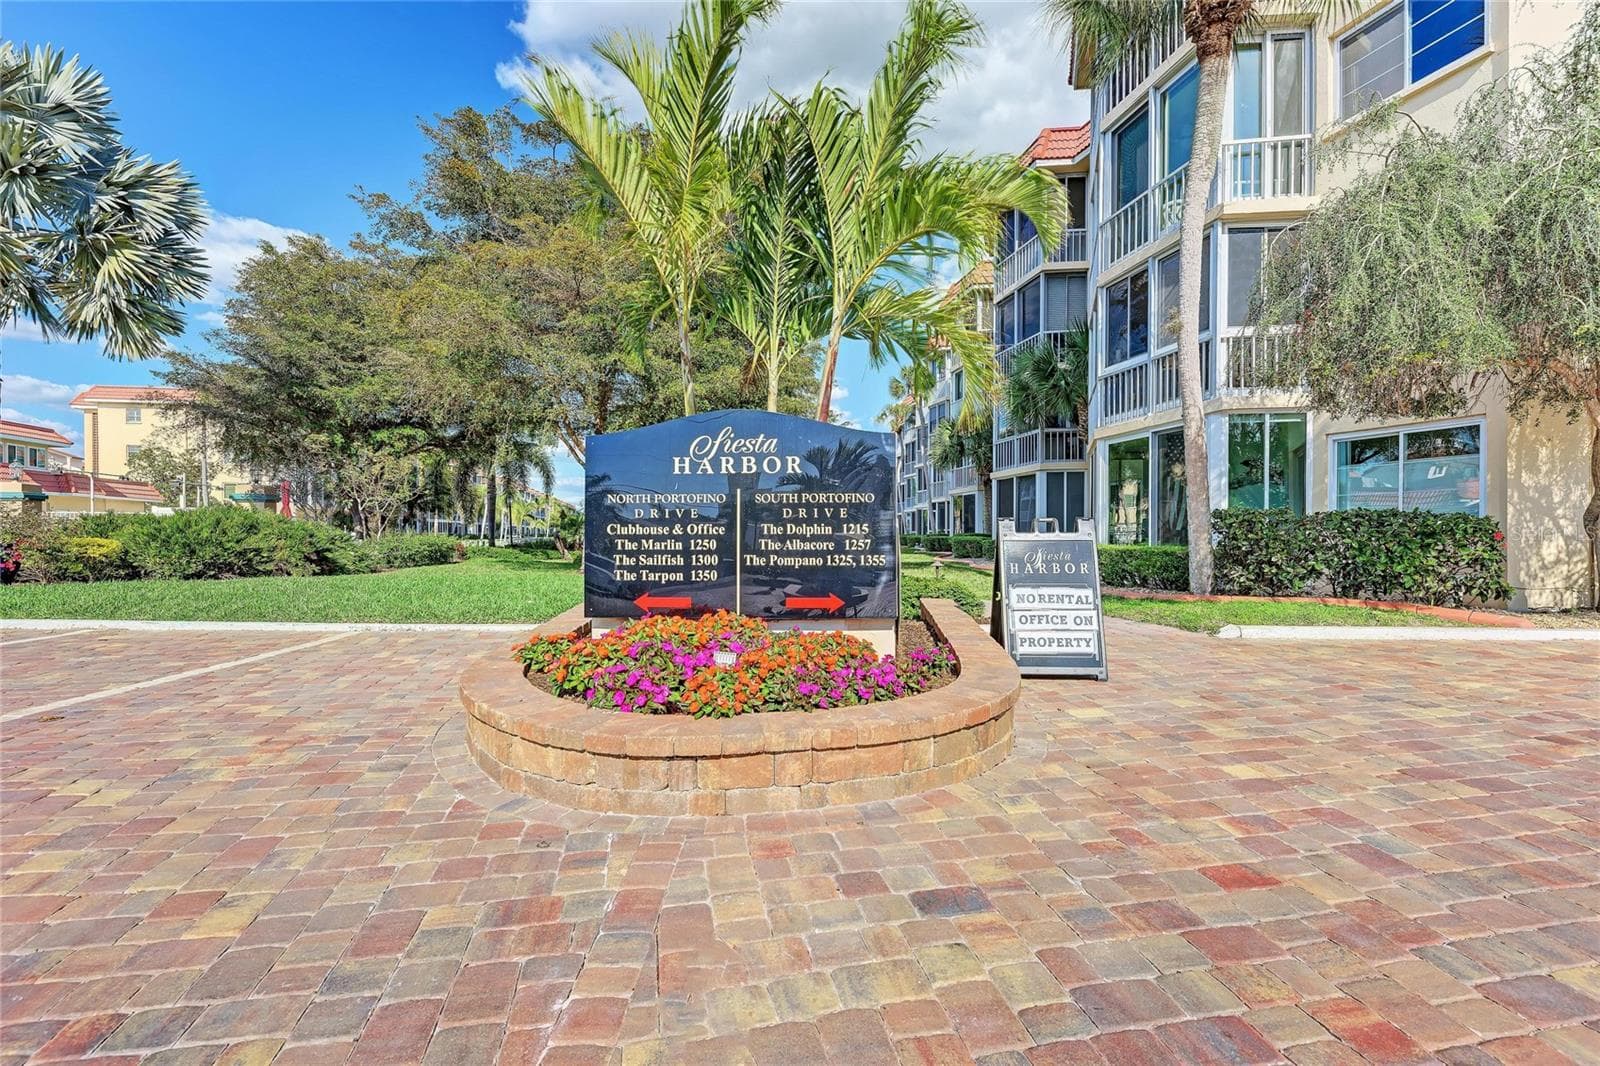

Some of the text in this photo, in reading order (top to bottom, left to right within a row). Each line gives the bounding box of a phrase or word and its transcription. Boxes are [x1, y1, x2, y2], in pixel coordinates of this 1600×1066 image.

[689, 426, 777, 462] Siesta
[672, 456, 803, 474] HARBOR
[607, 493, 726, 504] NORTH PORTOFINO
[754, 492, 875, 504] SOUTH PORTOFINO
[634, 508, 699, 519] DRIVE
[782, 507, 848, 519] DRIVE
[606, 523, 726, 536] Clubhouse & Office
[760, 523, 870, 537] The Dolphin 1215
[614, 539, 717, 551] The Marlin 1250
[758, 539, 871, 551] The Albacore 1257
[613, 554, 719, 566] The Sailfish 1300
[743, 554, 887, 568] The Pompano 1325, 1355
[1009, 562, 1090, 574] HARBOR
[613, 569, 718, 584] The Tarpon 1350
[1016, 593, 1092, 605] NO RENTAL
[1019, 614, 1094, 626] OFFICE ON
[1019, 637, 1093, 648] PROPERTY
